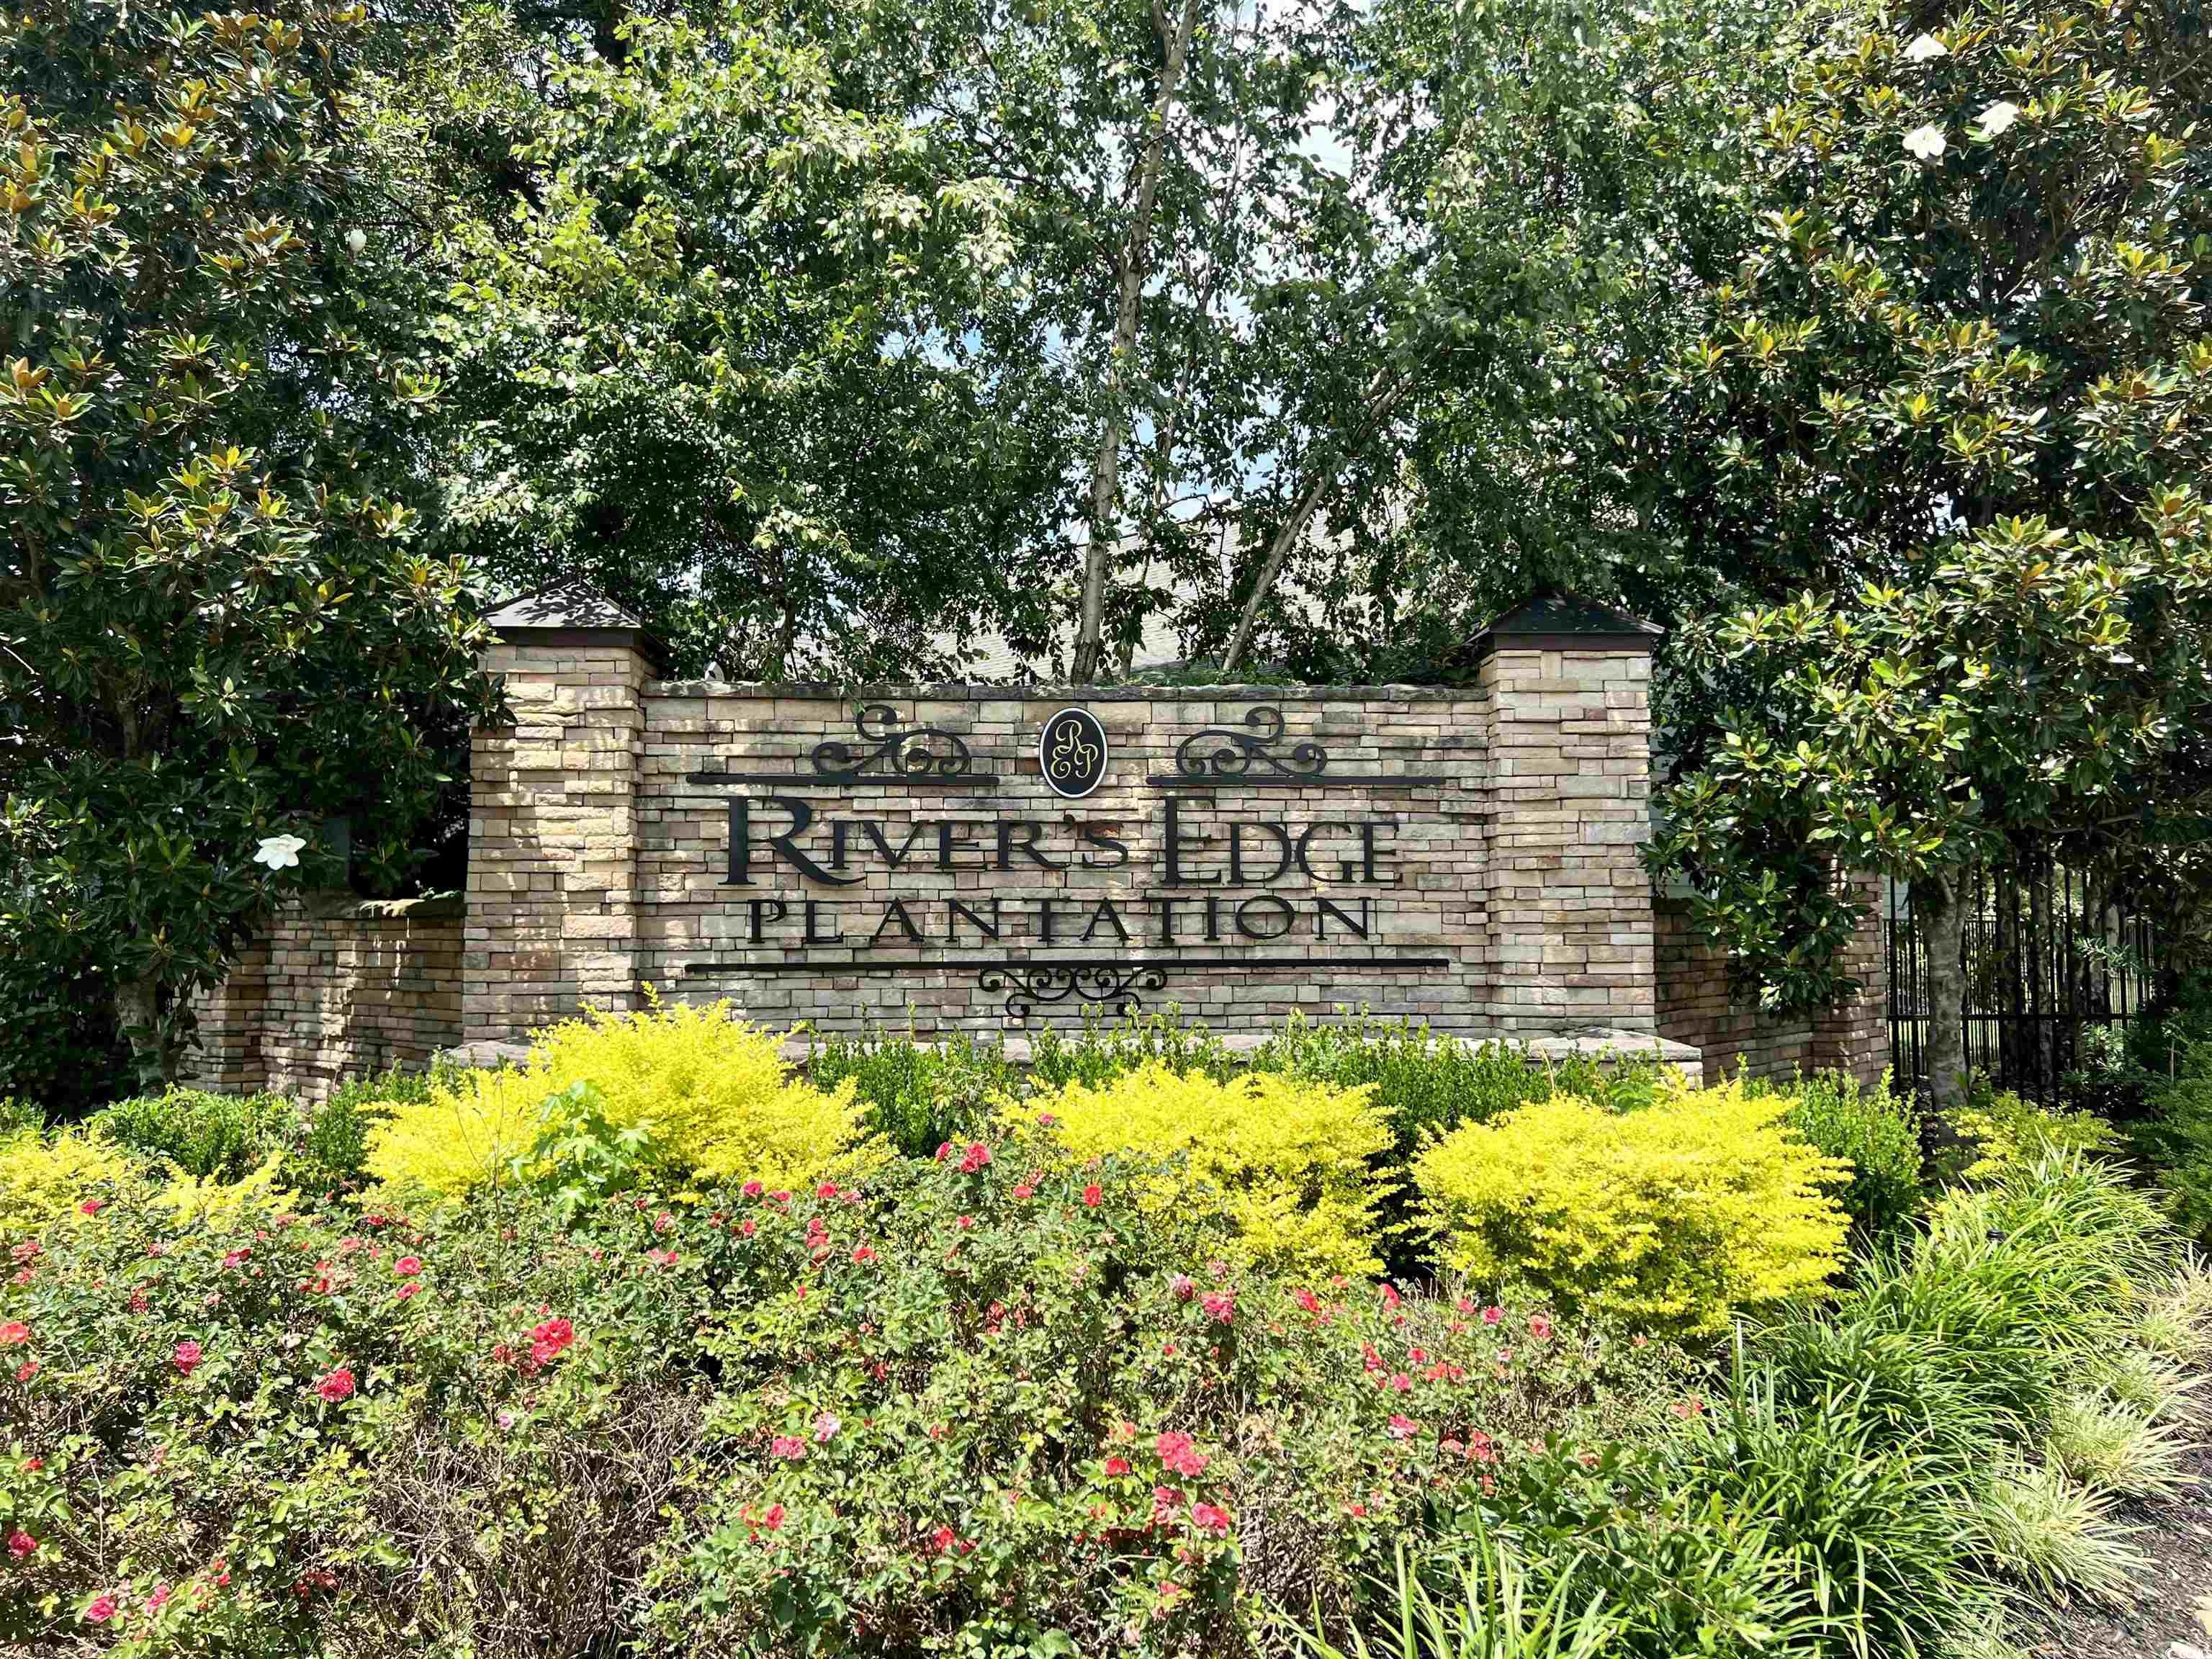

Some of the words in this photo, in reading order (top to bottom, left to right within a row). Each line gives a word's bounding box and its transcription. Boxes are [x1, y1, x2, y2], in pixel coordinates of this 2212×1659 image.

[718, 796, 1130, 886] RIVER'S
[1161, 795, 1403, 884] EDGE
[747, 896, 1371, 944] PLANTATION
